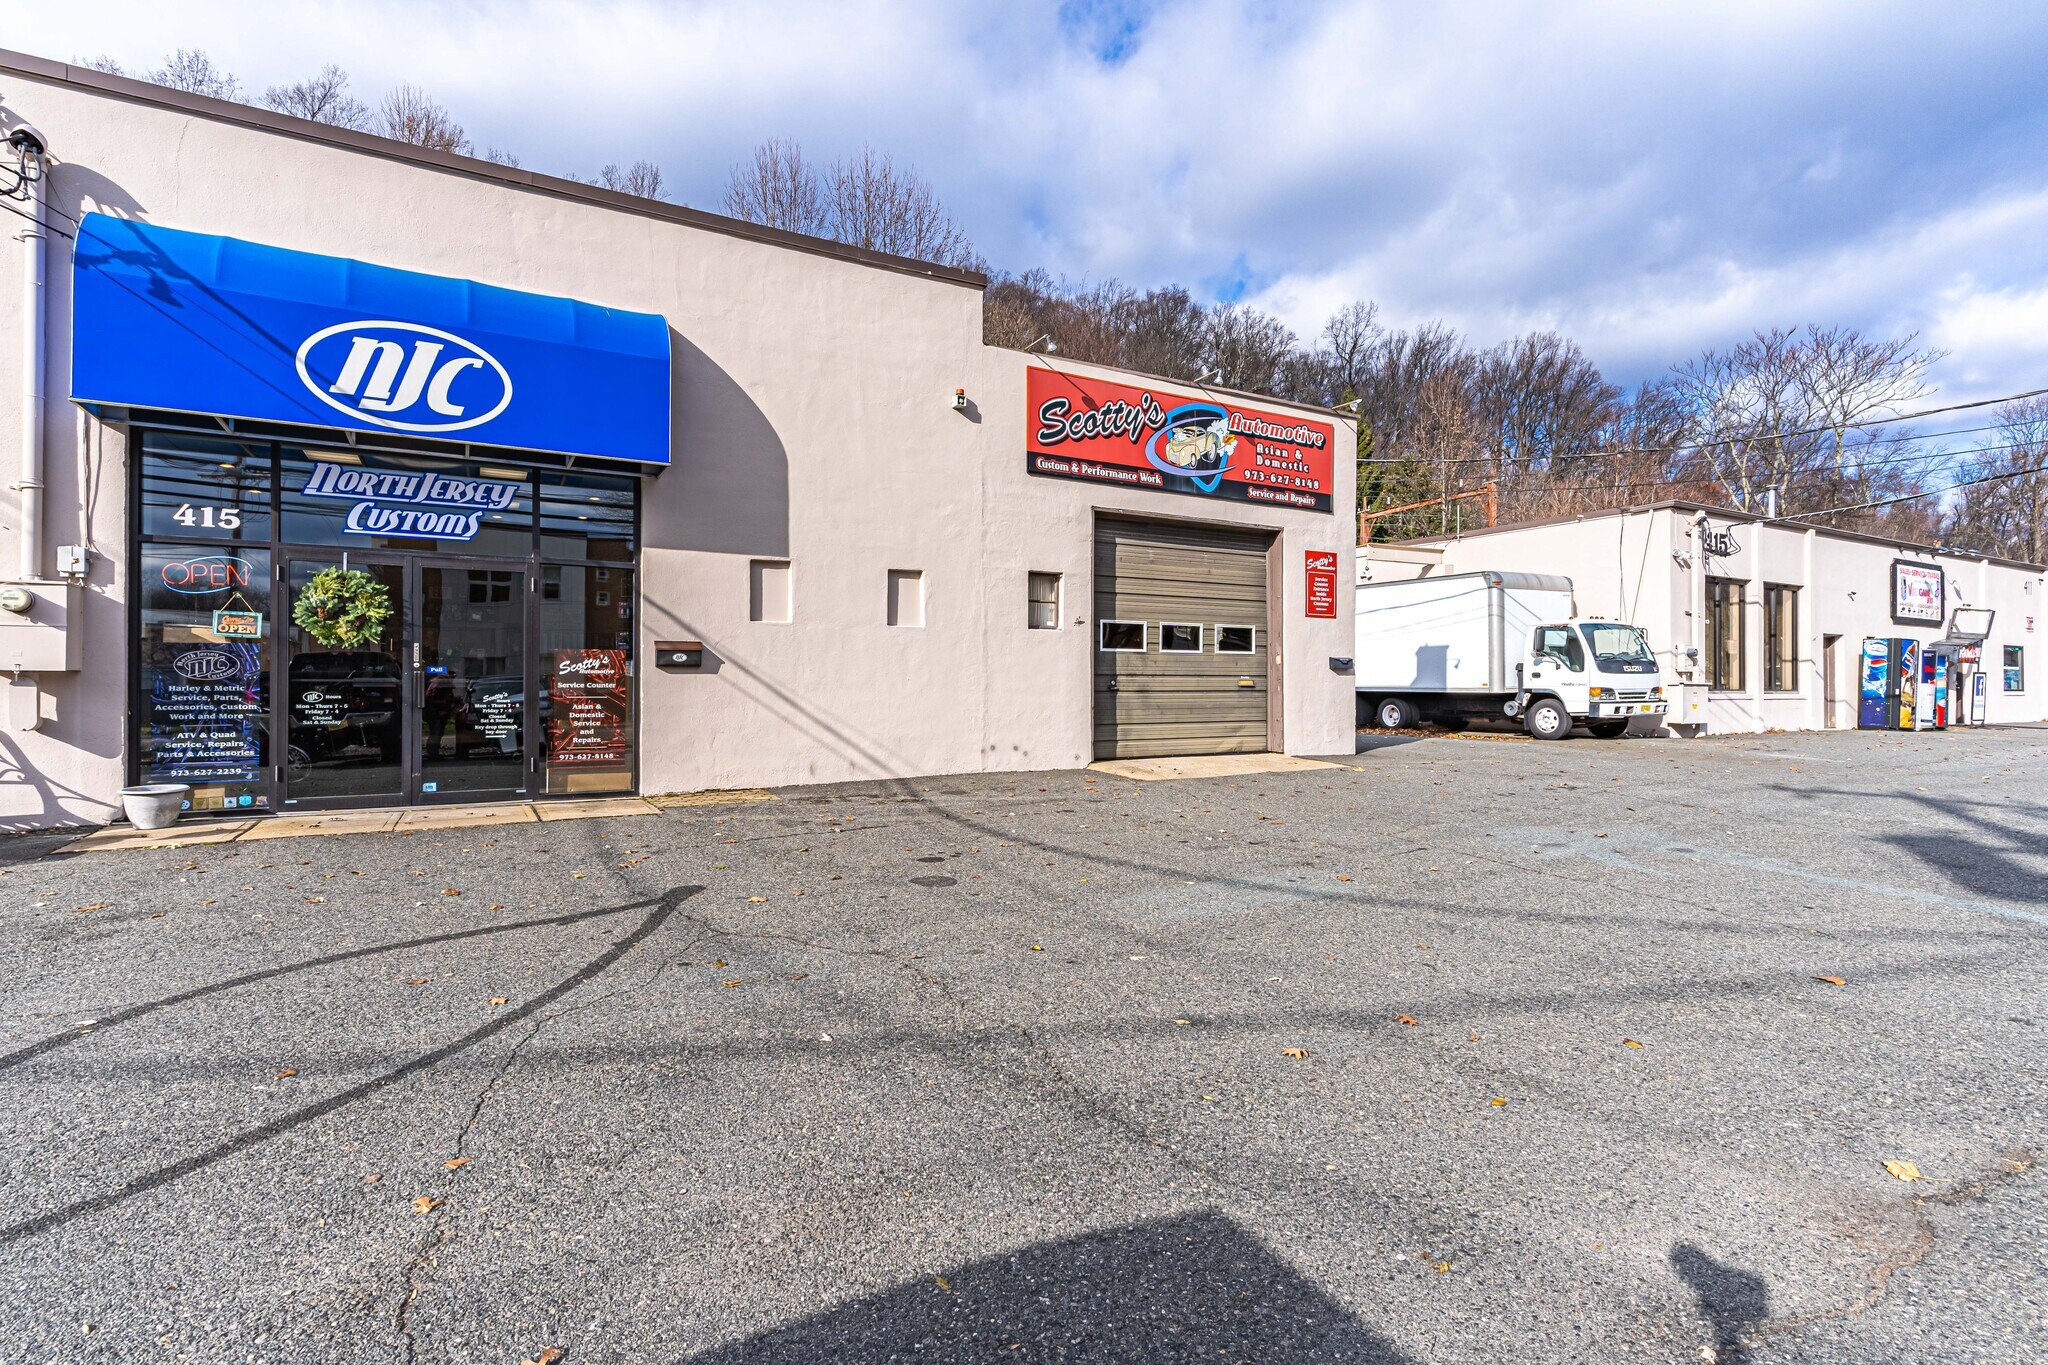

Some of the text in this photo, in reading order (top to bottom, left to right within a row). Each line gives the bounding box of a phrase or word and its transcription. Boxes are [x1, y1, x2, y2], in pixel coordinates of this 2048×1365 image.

[1037, 392, 1165, 442] Scotty's
[1229, 412, 1325, 447] Automotive
[1256, 443, 1303, 460] Asian &
[1037, 458, 1162, 484] Custom & Performance Work
[1256, 455, 1309, 473] Domestic
[1244, 470, 1320, 490] 973-627-8148
[1249, 488, 1315, 505] Service and Repairs
[173, 504, 240, 529] 415
[1307, 555, 1333, 570] Scotty's
[162, 563, 248, 586] OPEN
[218, 624, 256, 634] OPEN
[559, 655, 610, 675] Scotty's
[168, 685, 245, 694] Harley & Metric
[171, 694, 241, 702] Service, Parts,
[483, 692, 508, 702] Scotty's
[210, 731, 236, 739] Quad
[165, 740, 247, 749] Service, Repairs,
[196, 749, 255, 758] Accessories
[170, 768, 242, 777] 973-627-2239
